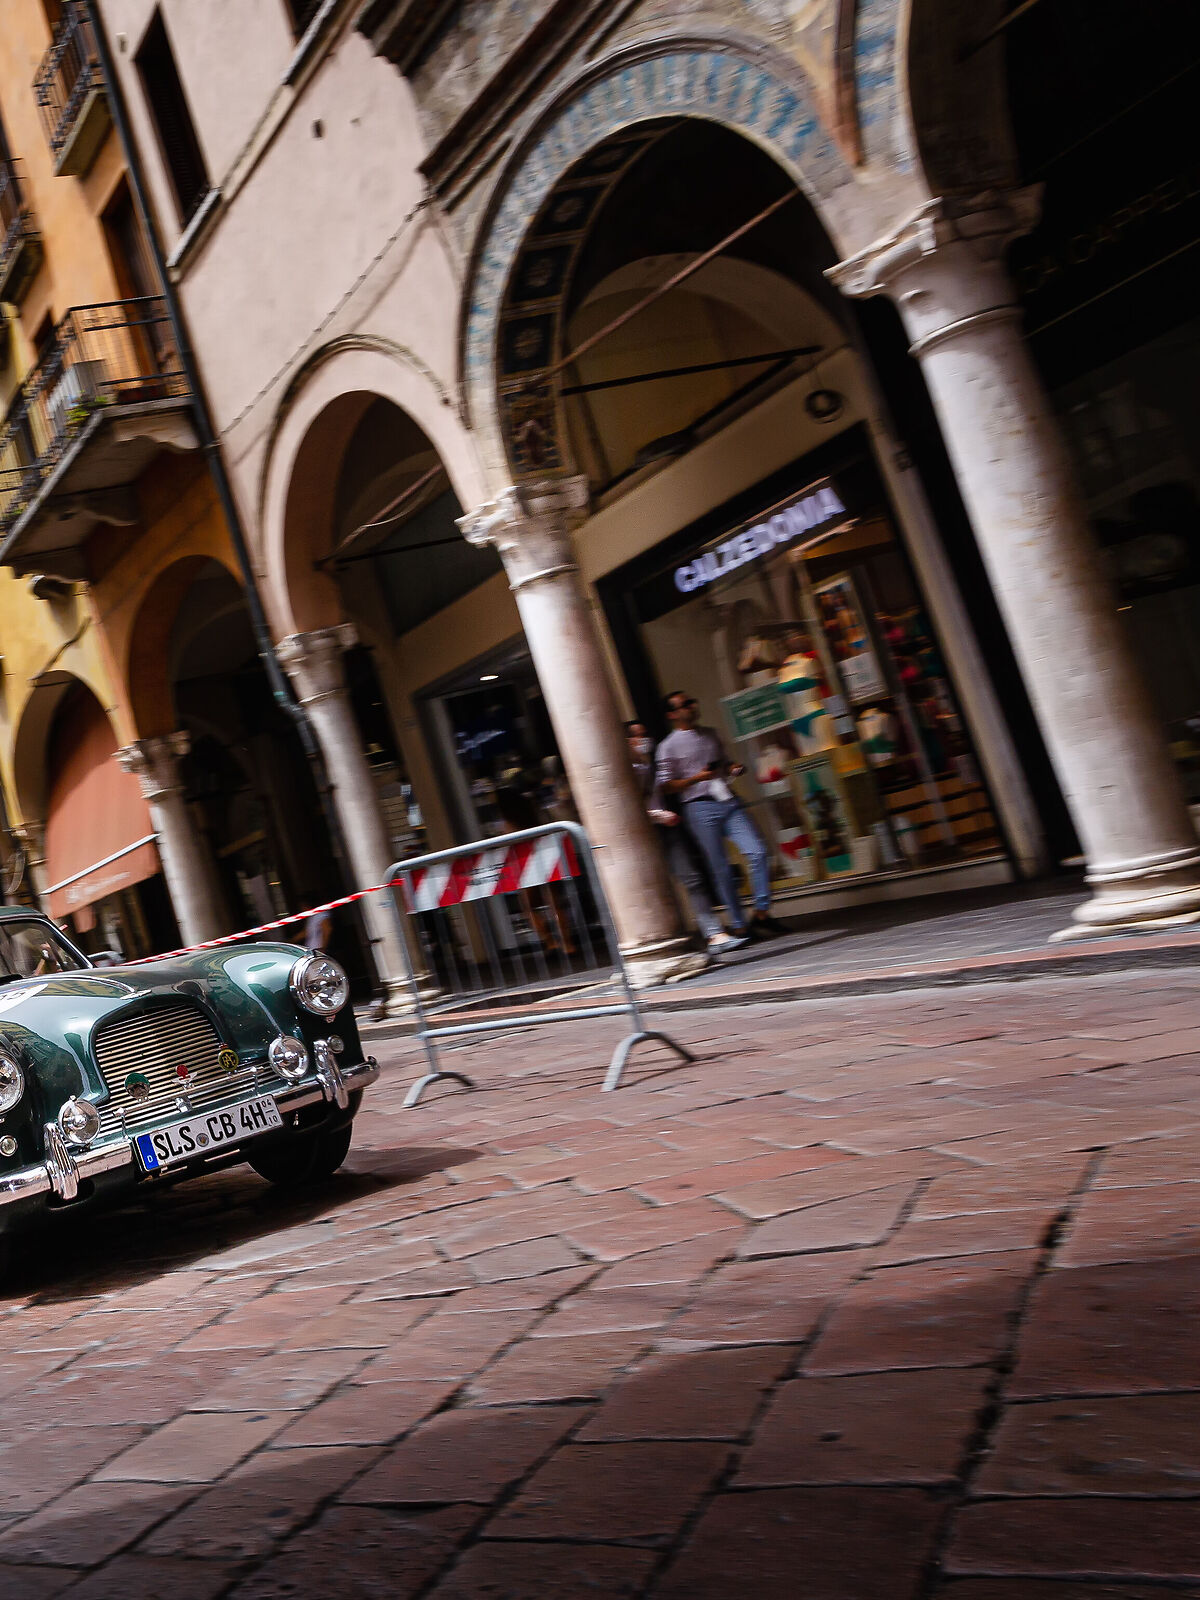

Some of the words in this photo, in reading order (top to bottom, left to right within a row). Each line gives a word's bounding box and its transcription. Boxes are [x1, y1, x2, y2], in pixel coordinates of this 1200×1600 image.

[674, 487, 846, 592] CALZEDONIA
[153, 1125, 196, 1160] SLS
[206, 1113, 236, 1142] CB
[240, 1101, 268, 1131] 4H
